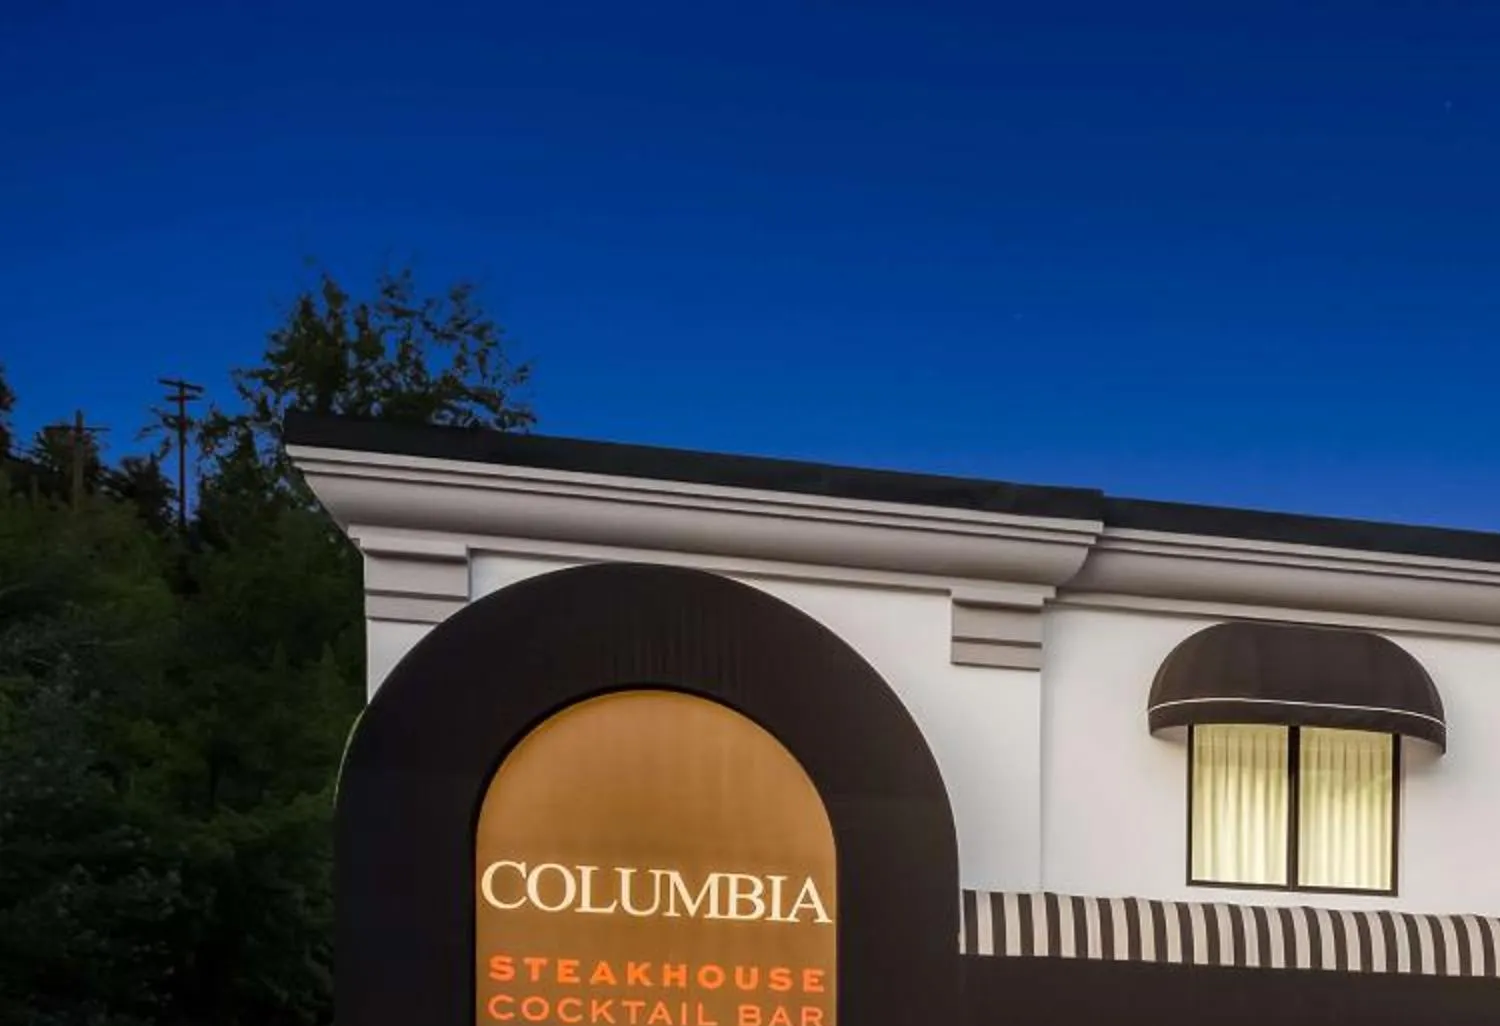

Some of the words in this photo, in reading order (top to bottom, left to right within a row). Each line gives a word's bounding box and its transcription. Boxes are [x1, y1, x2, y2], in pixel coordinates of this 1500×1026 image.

[481, 861, 833, 923] COLUMBIA
[488, 955, 826, 993] STEAKHOUSE
[487, 995, 719, 1026] COCKTAIL
